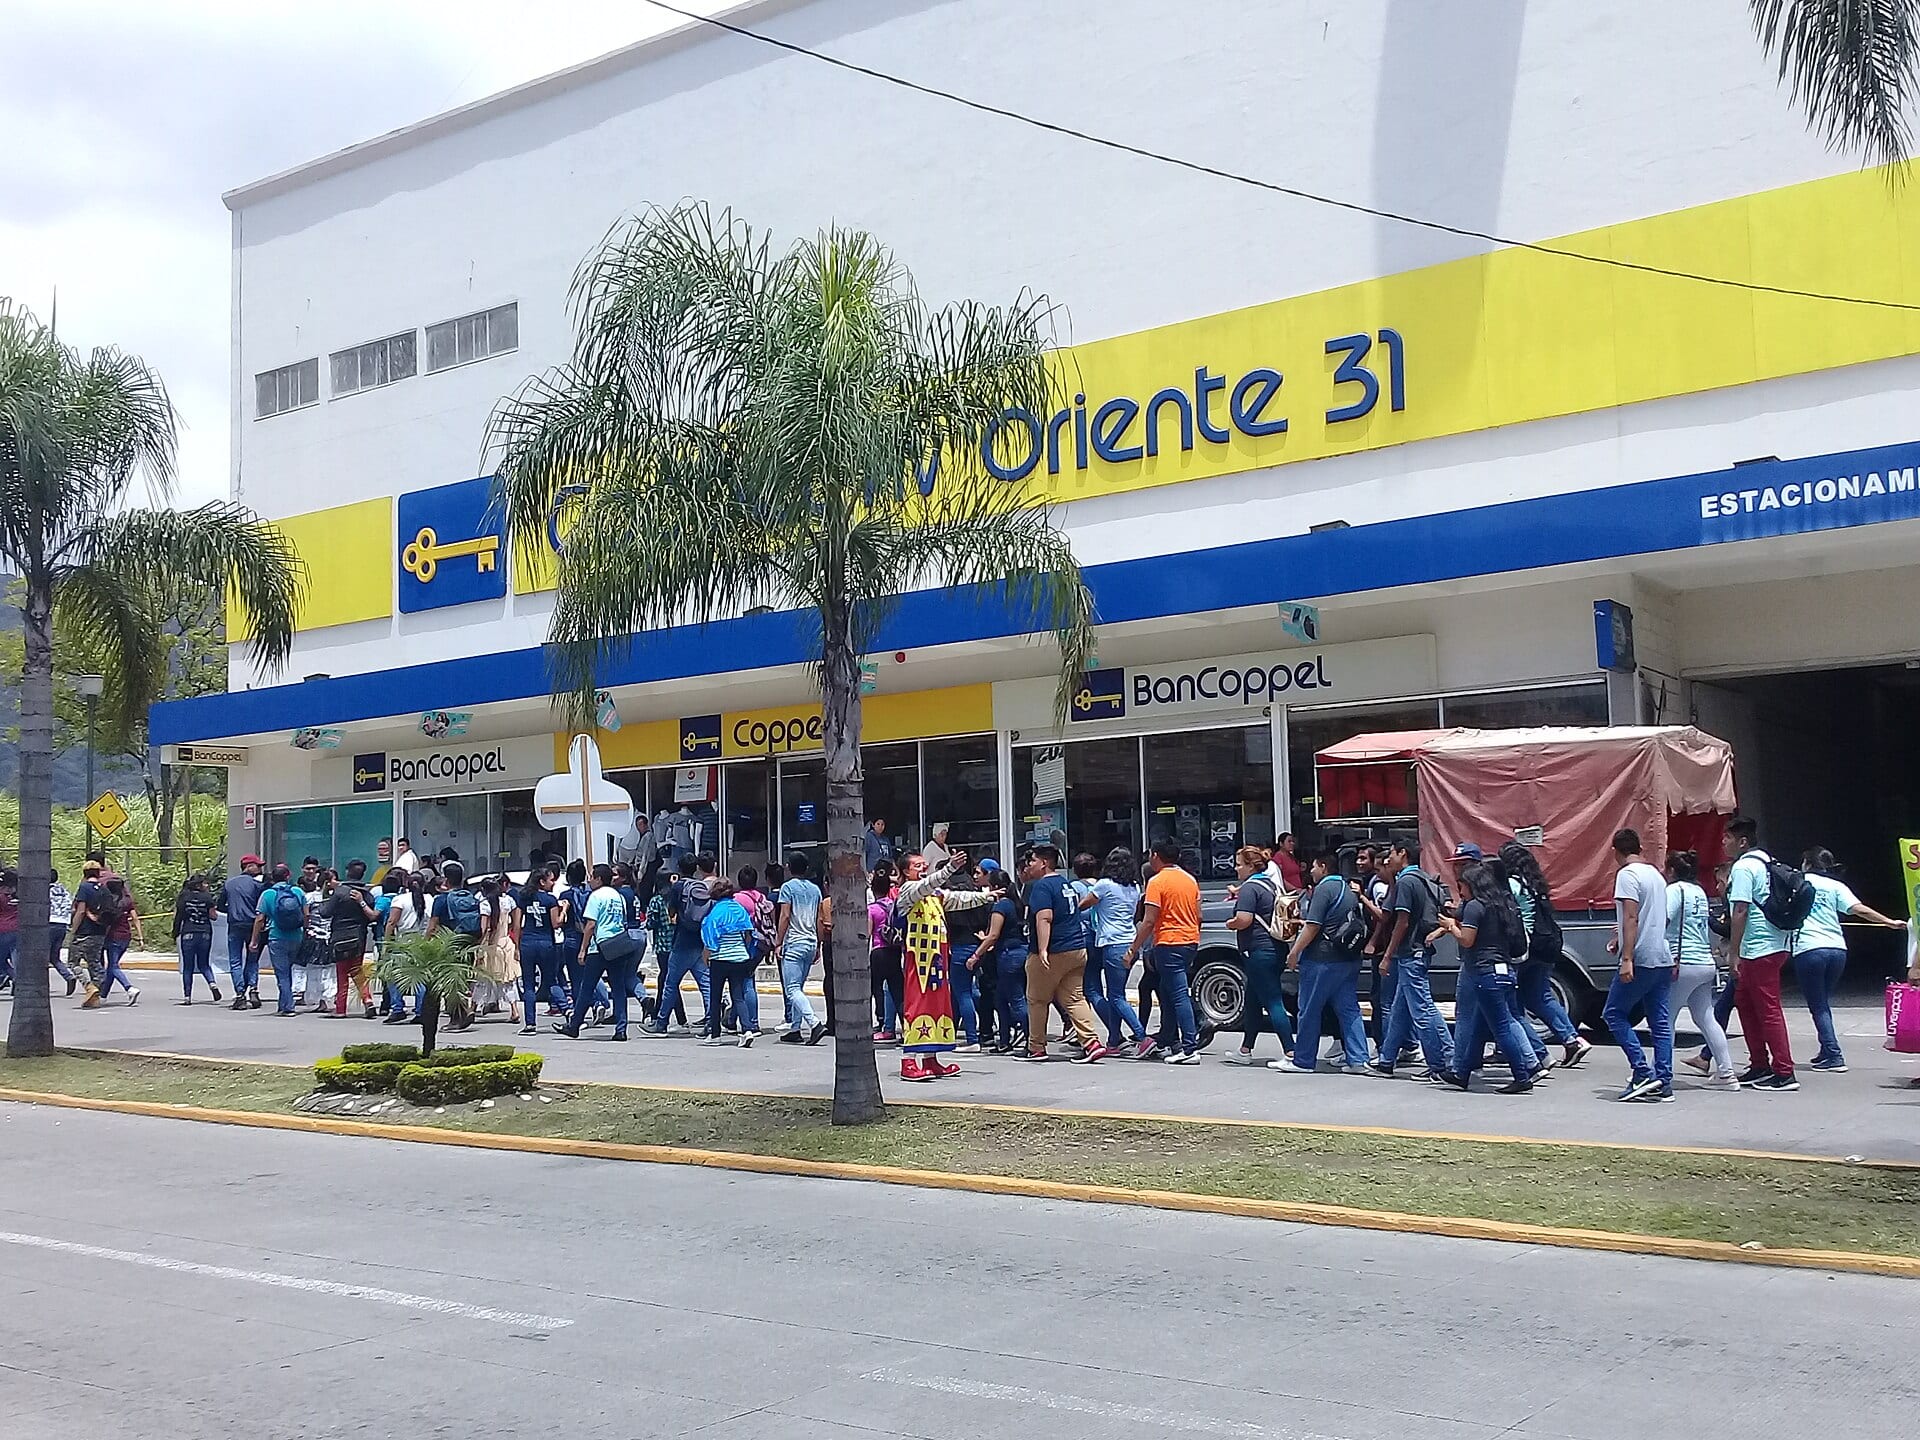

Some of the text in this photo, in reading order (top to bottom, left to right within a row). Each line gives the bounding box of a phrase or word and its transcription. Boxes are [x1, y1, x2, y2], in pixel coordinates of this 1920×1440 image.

[981, 365, 1288, 482] Oriente
[1325, 328, 1405, 425] 31
[1133, 655, 1331, 707] BanCoppel
[733, 715, 824, 753] Coppe
[194, 750, 243, 763] BanCoppel
[391, 746, 506, 783] BanCoppel
